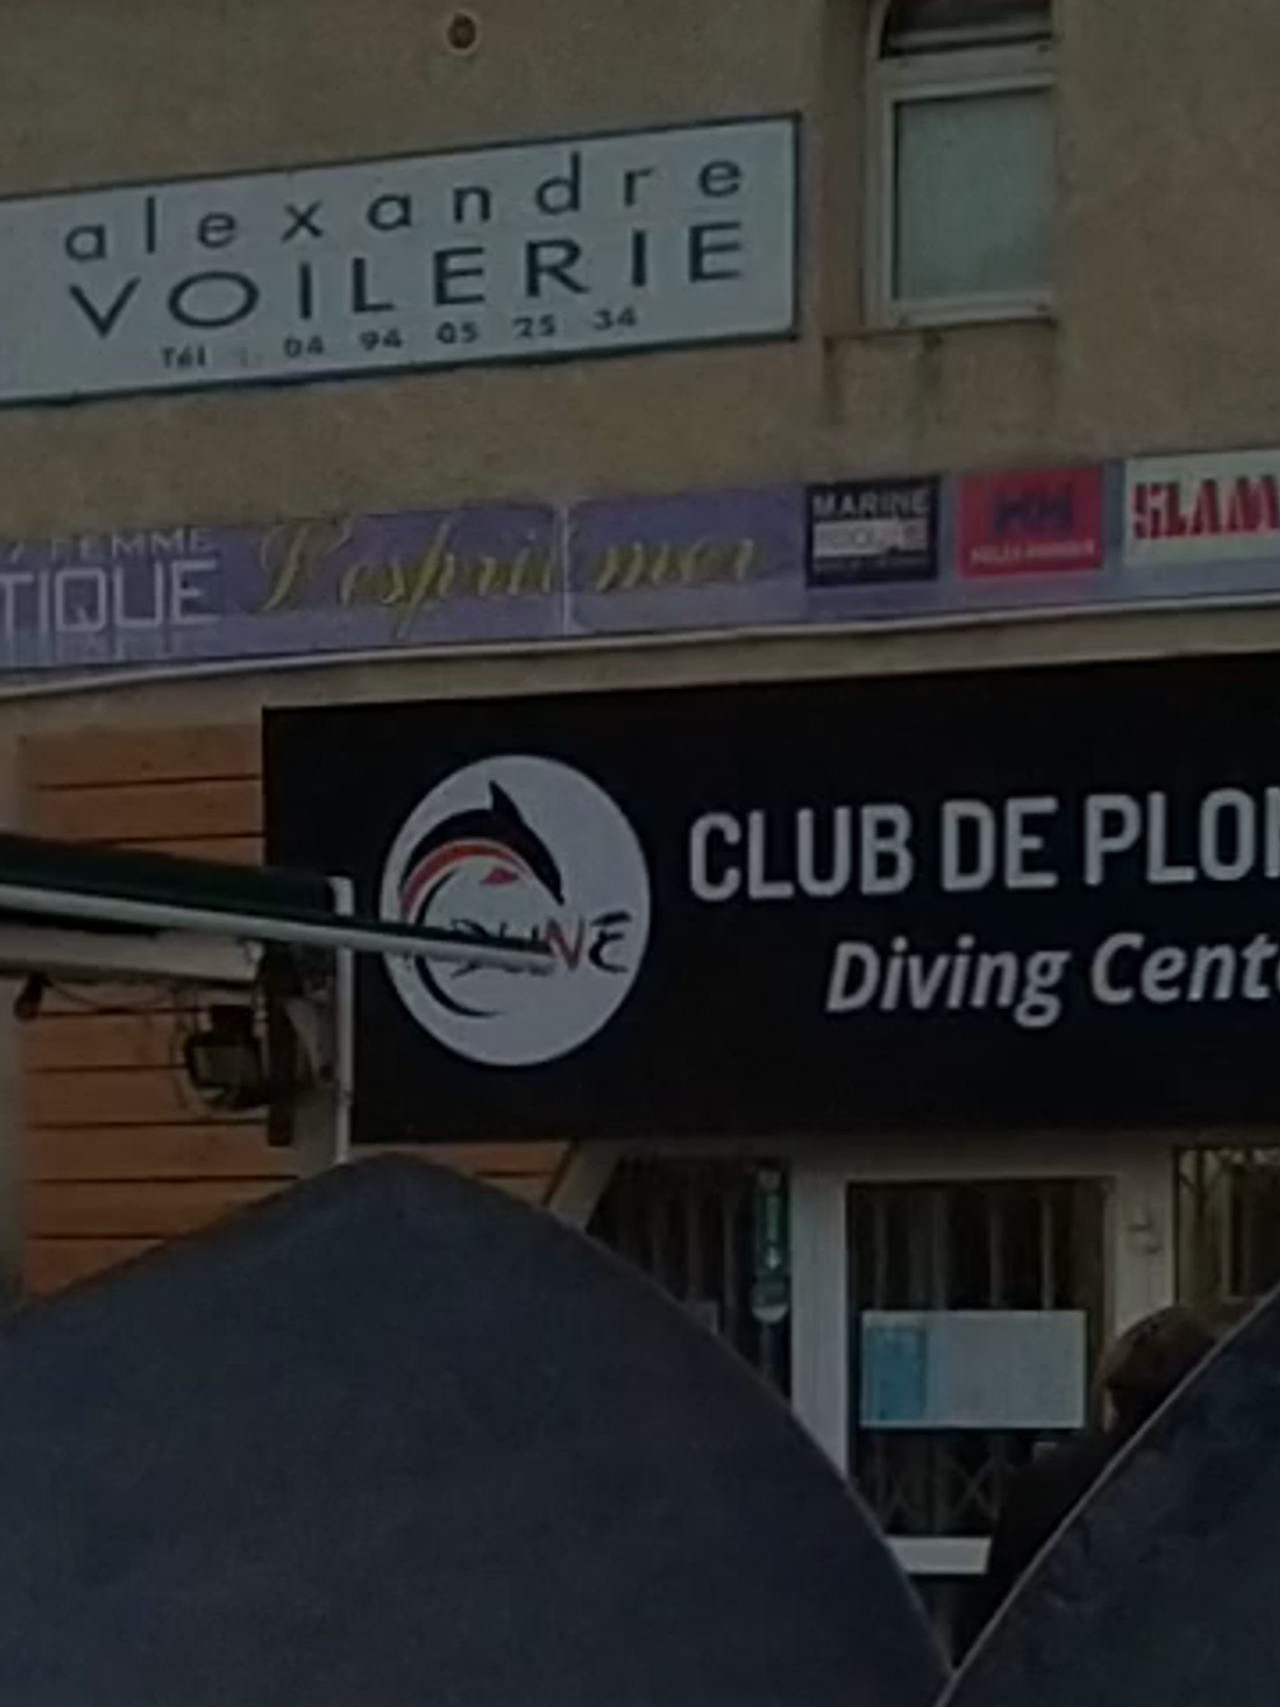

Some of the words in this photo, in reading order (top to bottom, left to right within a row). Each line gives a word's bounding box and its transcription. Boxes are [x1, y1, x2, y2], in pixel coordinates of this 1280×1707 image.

[64, 151, 743, 262] alexandre
[68, 221, 742, 337] VOILERIE
[284, 336, 325, 358] 04
[360, 330, 402, 351] 94
[435, 321, 479, 344] 05
[515, 316, 557, 338] 25
[593, 307, 637, 331] 34
[49, 527, 219, 560] FEMME
[815, 487, 932, 519] MARINE
[687, 803, 916, 902] CLUB
[939, 795, 1061, 892] DE
[823, 931, 1074, 1032] Diving
